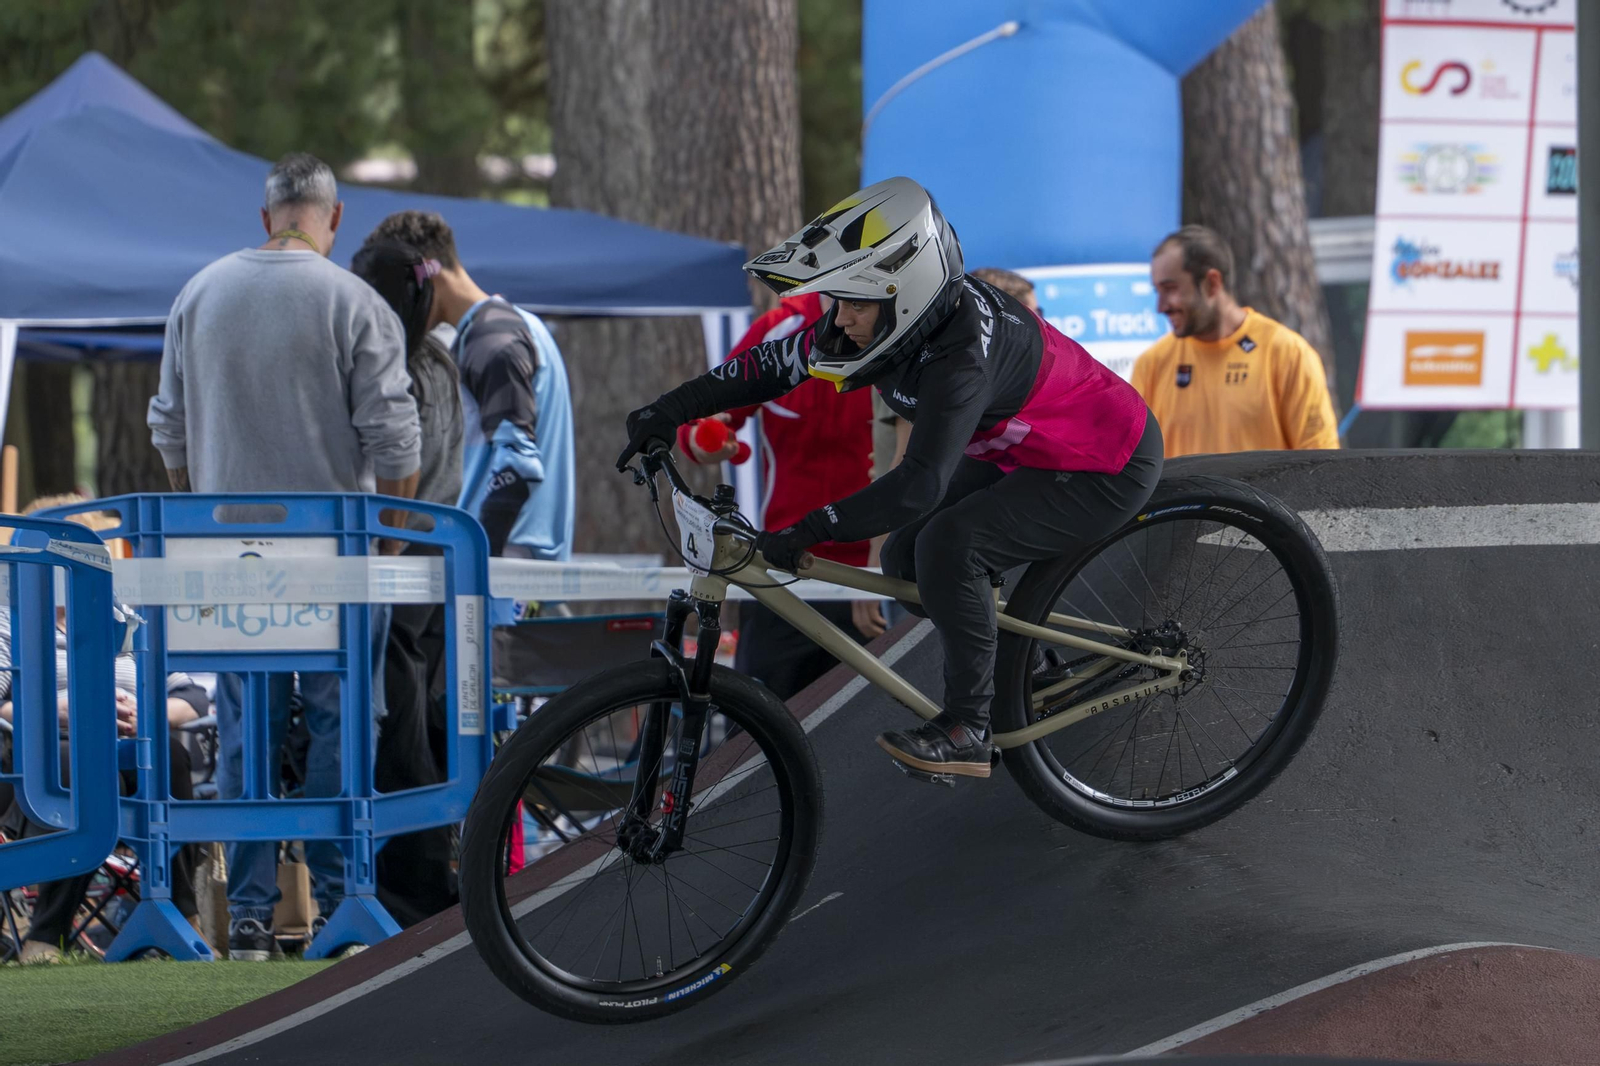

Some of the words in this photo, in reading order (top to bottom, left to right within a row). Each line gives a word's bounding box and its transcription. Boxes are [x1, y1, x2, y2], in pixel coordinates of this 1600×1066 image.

[1090, 308, 1157, 335] Track
[1209, 505, 1242, 514] PILOT
[687, 532, 699, 559] 4
[668, 974, 714, 1000] MICHELIN
[624, 997, 658, 1008] PILOT
